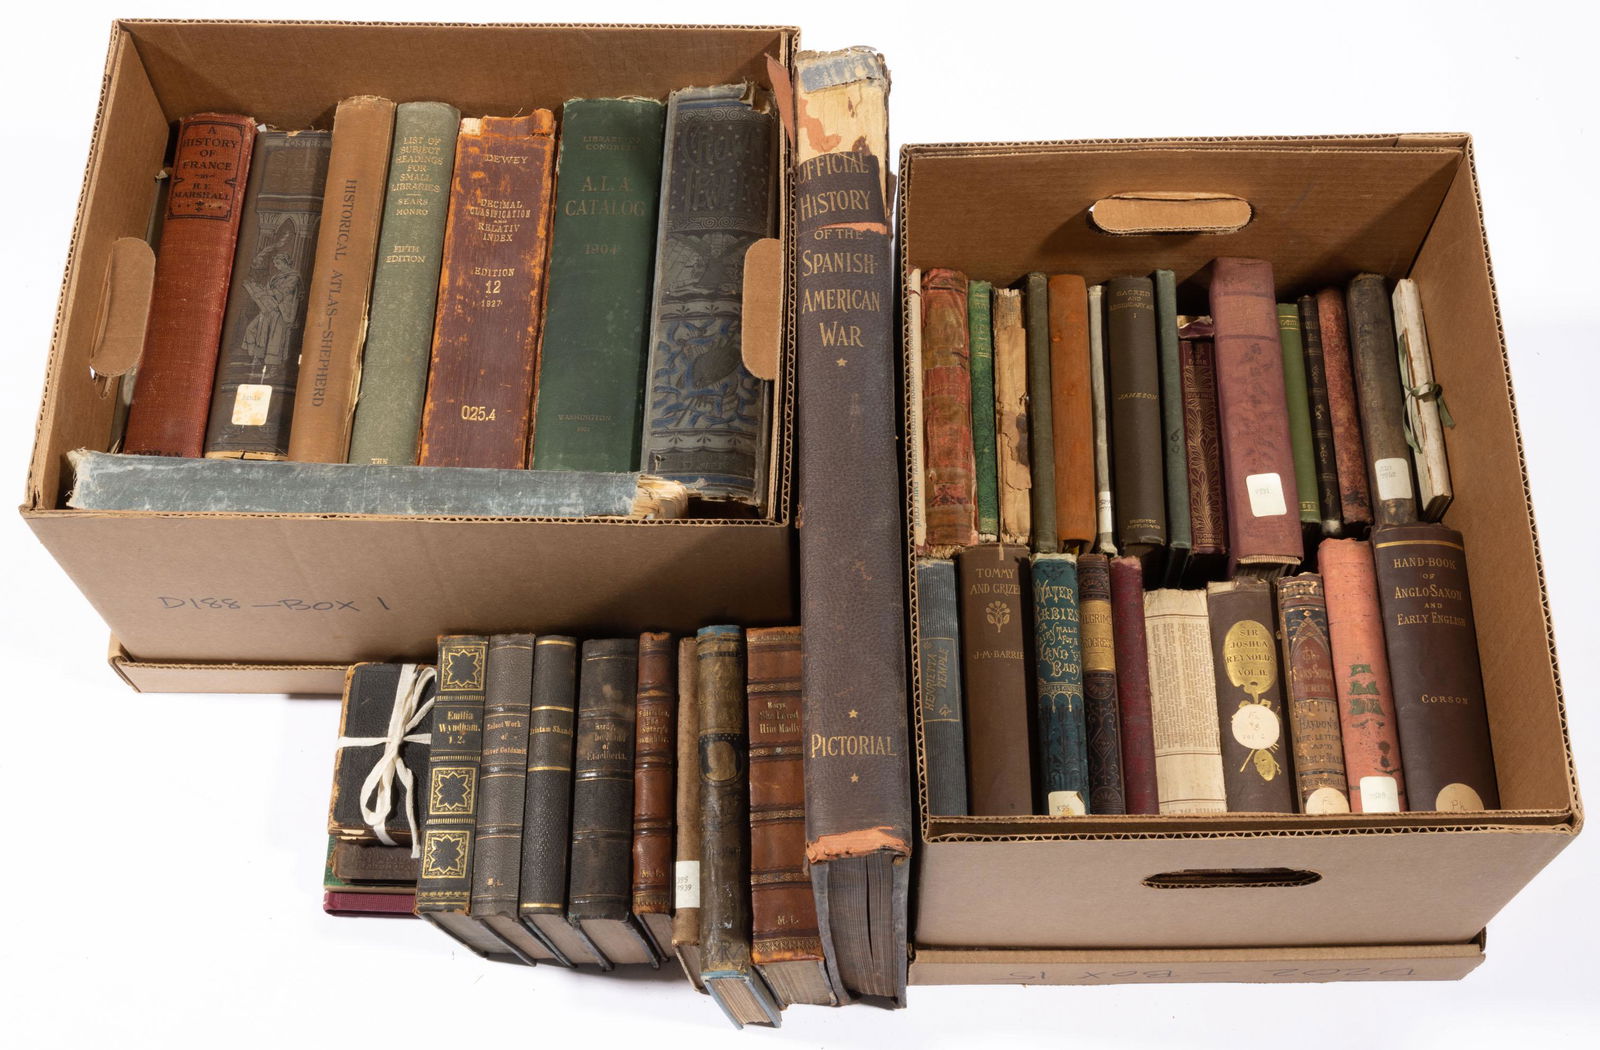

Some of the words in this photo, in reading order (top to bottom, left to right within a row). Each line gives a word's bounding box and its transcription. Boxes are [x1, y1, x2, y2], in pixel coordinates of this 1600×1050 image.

[208, 126, 216, 134] A
[183, 138, 239, 148] HISTORY
[403, 137, 423, 145] LIST
[428, 137, 442, 145] OF
[400, 146, 441, 155] SUBJECT
[484, 155, 529, 165] DEWEY
[182, 161, 233, 171] FRANCE
[400, 174, 432, 182] SMALL
[391, 183, 441, 193] LIBRARIES
[174, 191, 231, 200] MARSHALL
[480, 199, 523, 209] DECIMAL
[565, 200, 647, 217] CATALOG
[800, 190, 871, 220] HISTORY
[469, 207, 531, 219] CLASIFICATION
[334, 179, 358, 261] HISTORICAL
[478, 223, 521, 232] RELATIV
[482, 233, 513, 242] INDEX
[814, 229, 832, 241] OF
[836, 229, 864, 240] THE
[393, 245, 420, 253] FIFTH
[385, 255, 427, 263] EDITION
[474, 267, 516, 277] EDITION
[485, 280, 502, 294] 12
[481, 300, 502, 308] 1927
[802, 288, 880, 314] AMERICAN
[819, 321, 864, 347] WAR
[461, 405, 497, 421] 025.4
[1393, 558, 1457, 570] HAND-BOOK
[975, 568, 1015, 579] TOMMY
[970, 583, 990, 595] AND
[158, 596, 241, 610] D188
[1397, 612, 1429, 626] EARLY
[1239, 629, 1258, 637] SIR
[1230, 640, 1269, 649] JOSHUA
[1226, 655, 1273, 664] REYNOLDS
[447, 711, 474, 720] Emilia
[811, 733, 897, 759] PICTORIAL
